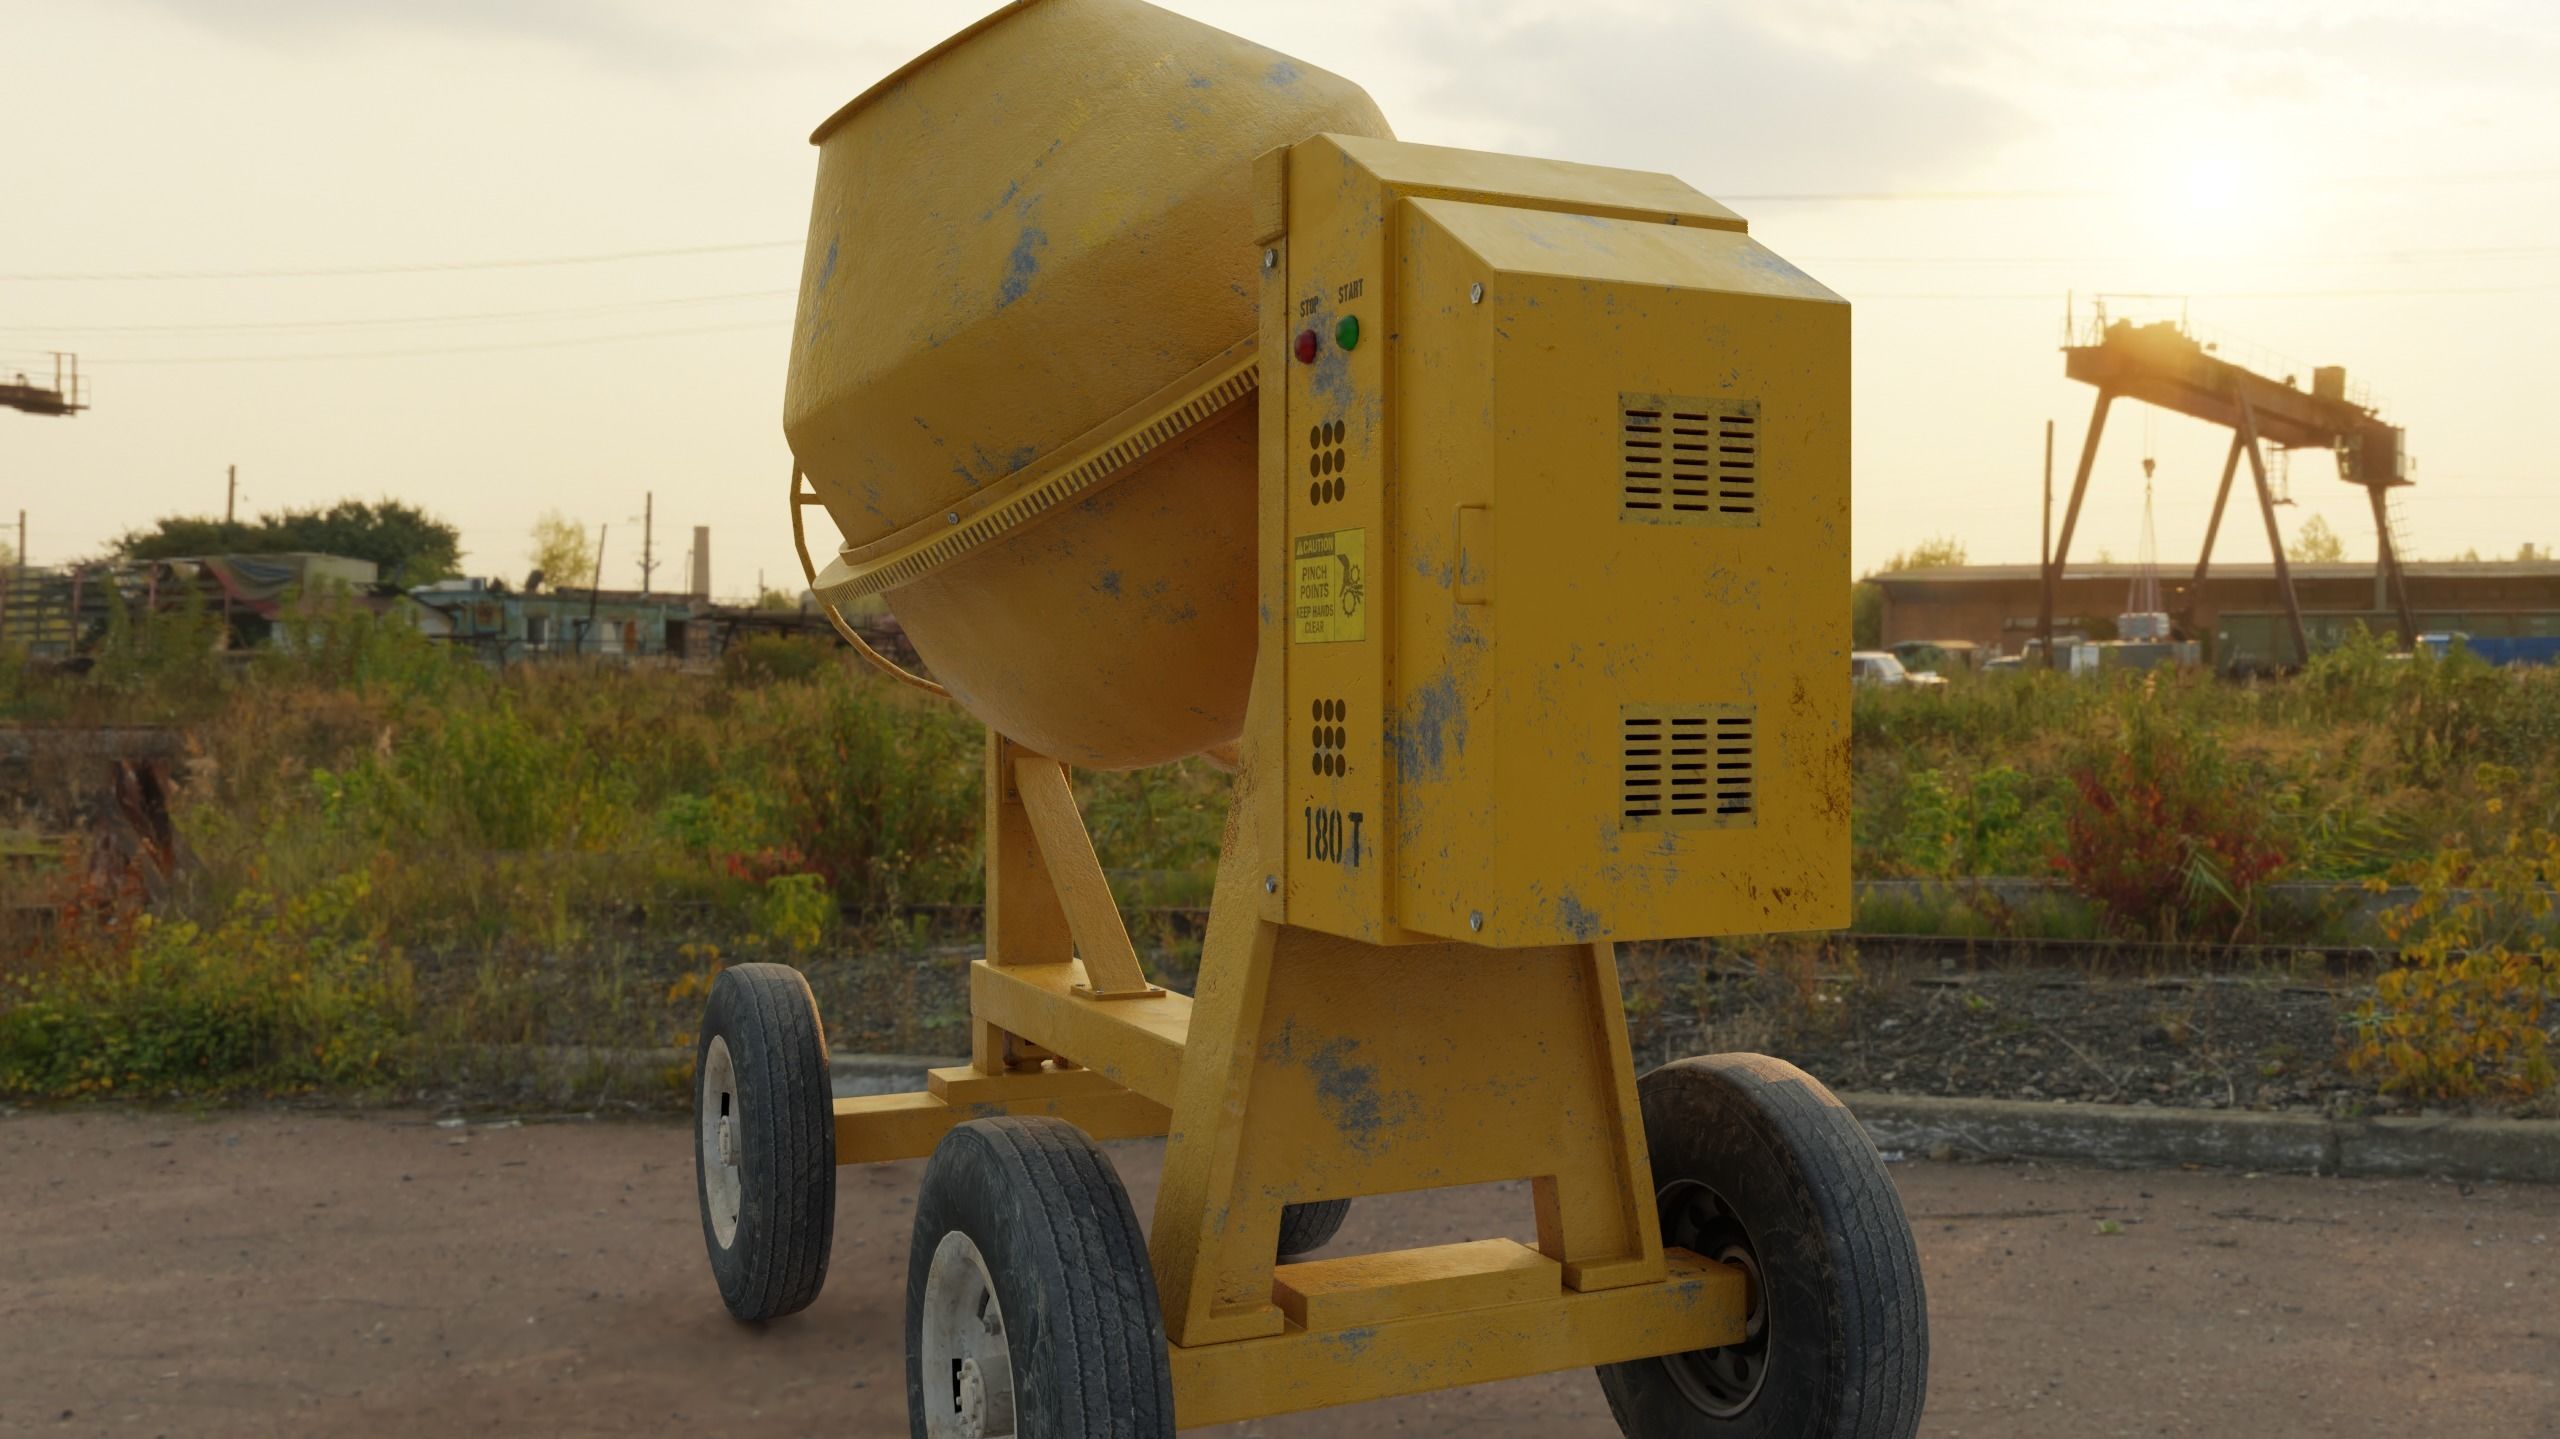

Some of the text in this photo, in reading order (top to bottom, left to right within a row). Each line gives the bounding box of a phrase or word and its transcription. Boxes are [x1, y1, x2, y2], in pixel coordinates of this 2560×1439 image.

[1338, 278, 1364, 304] START
[1300, 296, 1319, 317] STOP
[1304, 537, 1334, 554] CAUTION
[1302, 565, 1327, 582] PINCH
[1301, 584, 1329, 600] POINTS
[1297, 604, 1334, 619] KEEP HANDS
[1305, 621, 1324, 634] CLEAR
[1305, 806, 1363, 868] 180 T
